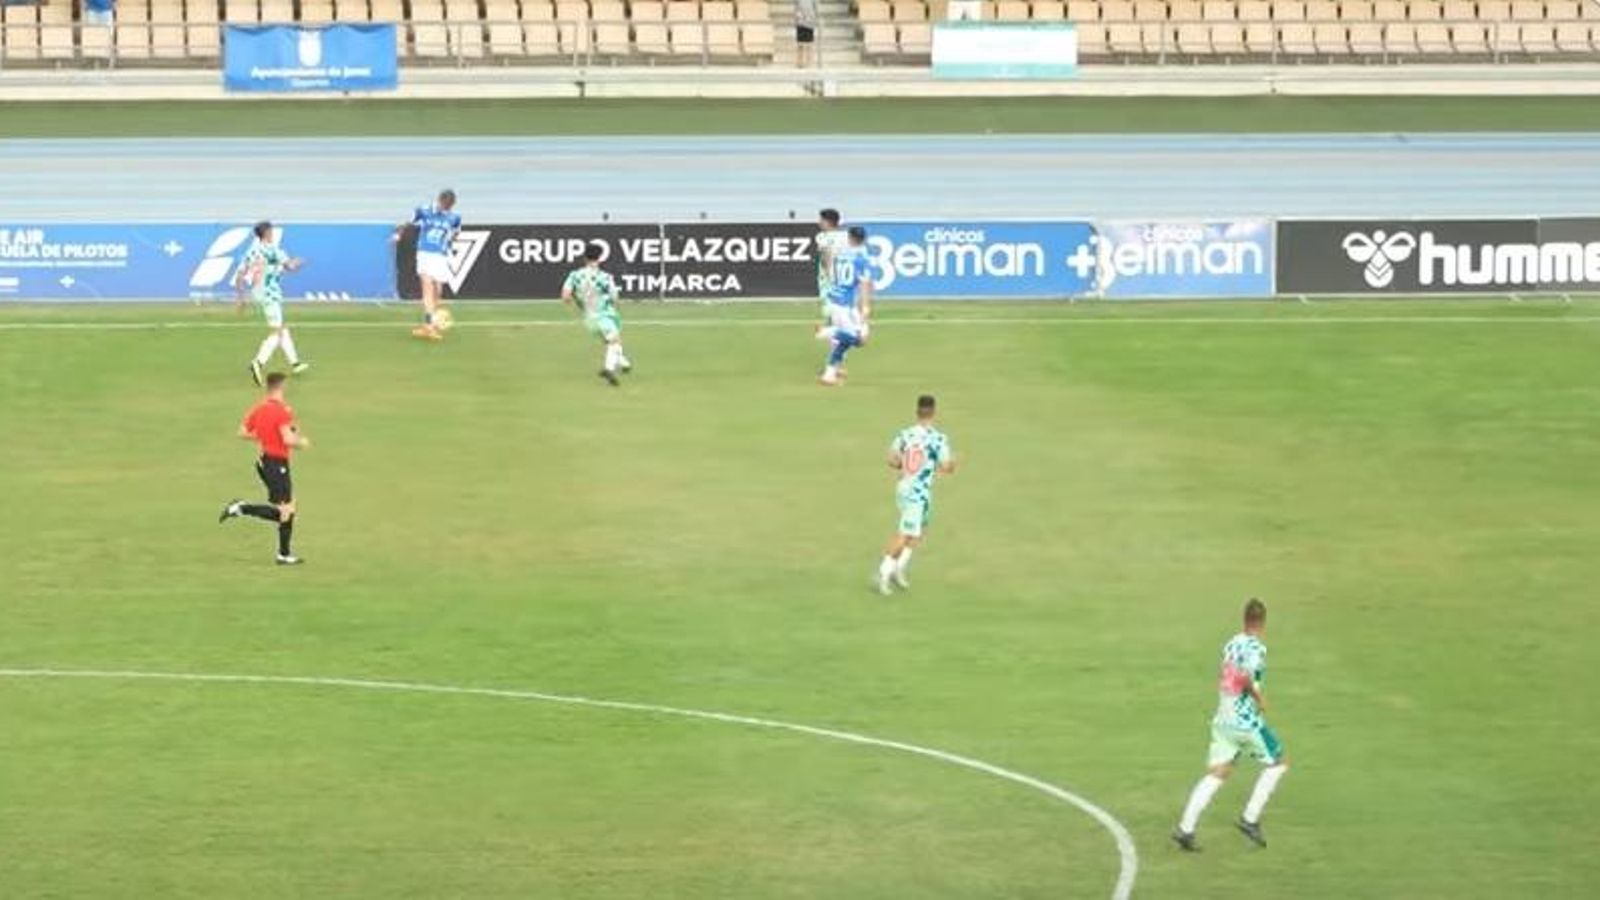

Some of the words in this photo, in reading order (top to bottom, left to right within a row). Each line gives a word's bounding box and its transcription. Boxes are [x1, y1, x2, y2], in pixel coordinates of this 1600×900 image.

[14, 230, 43, 244] AIR
[42, 244, 60, 258] DE
[63, 244, 128, 258] PILOTOS
[499, 239, 611, 263] GRUPO
[619, 238, 811, 262] VELAZQUEZ
[836, 257, 855, 286] 10
[610, 274, 742, 292] LTIMARCA
